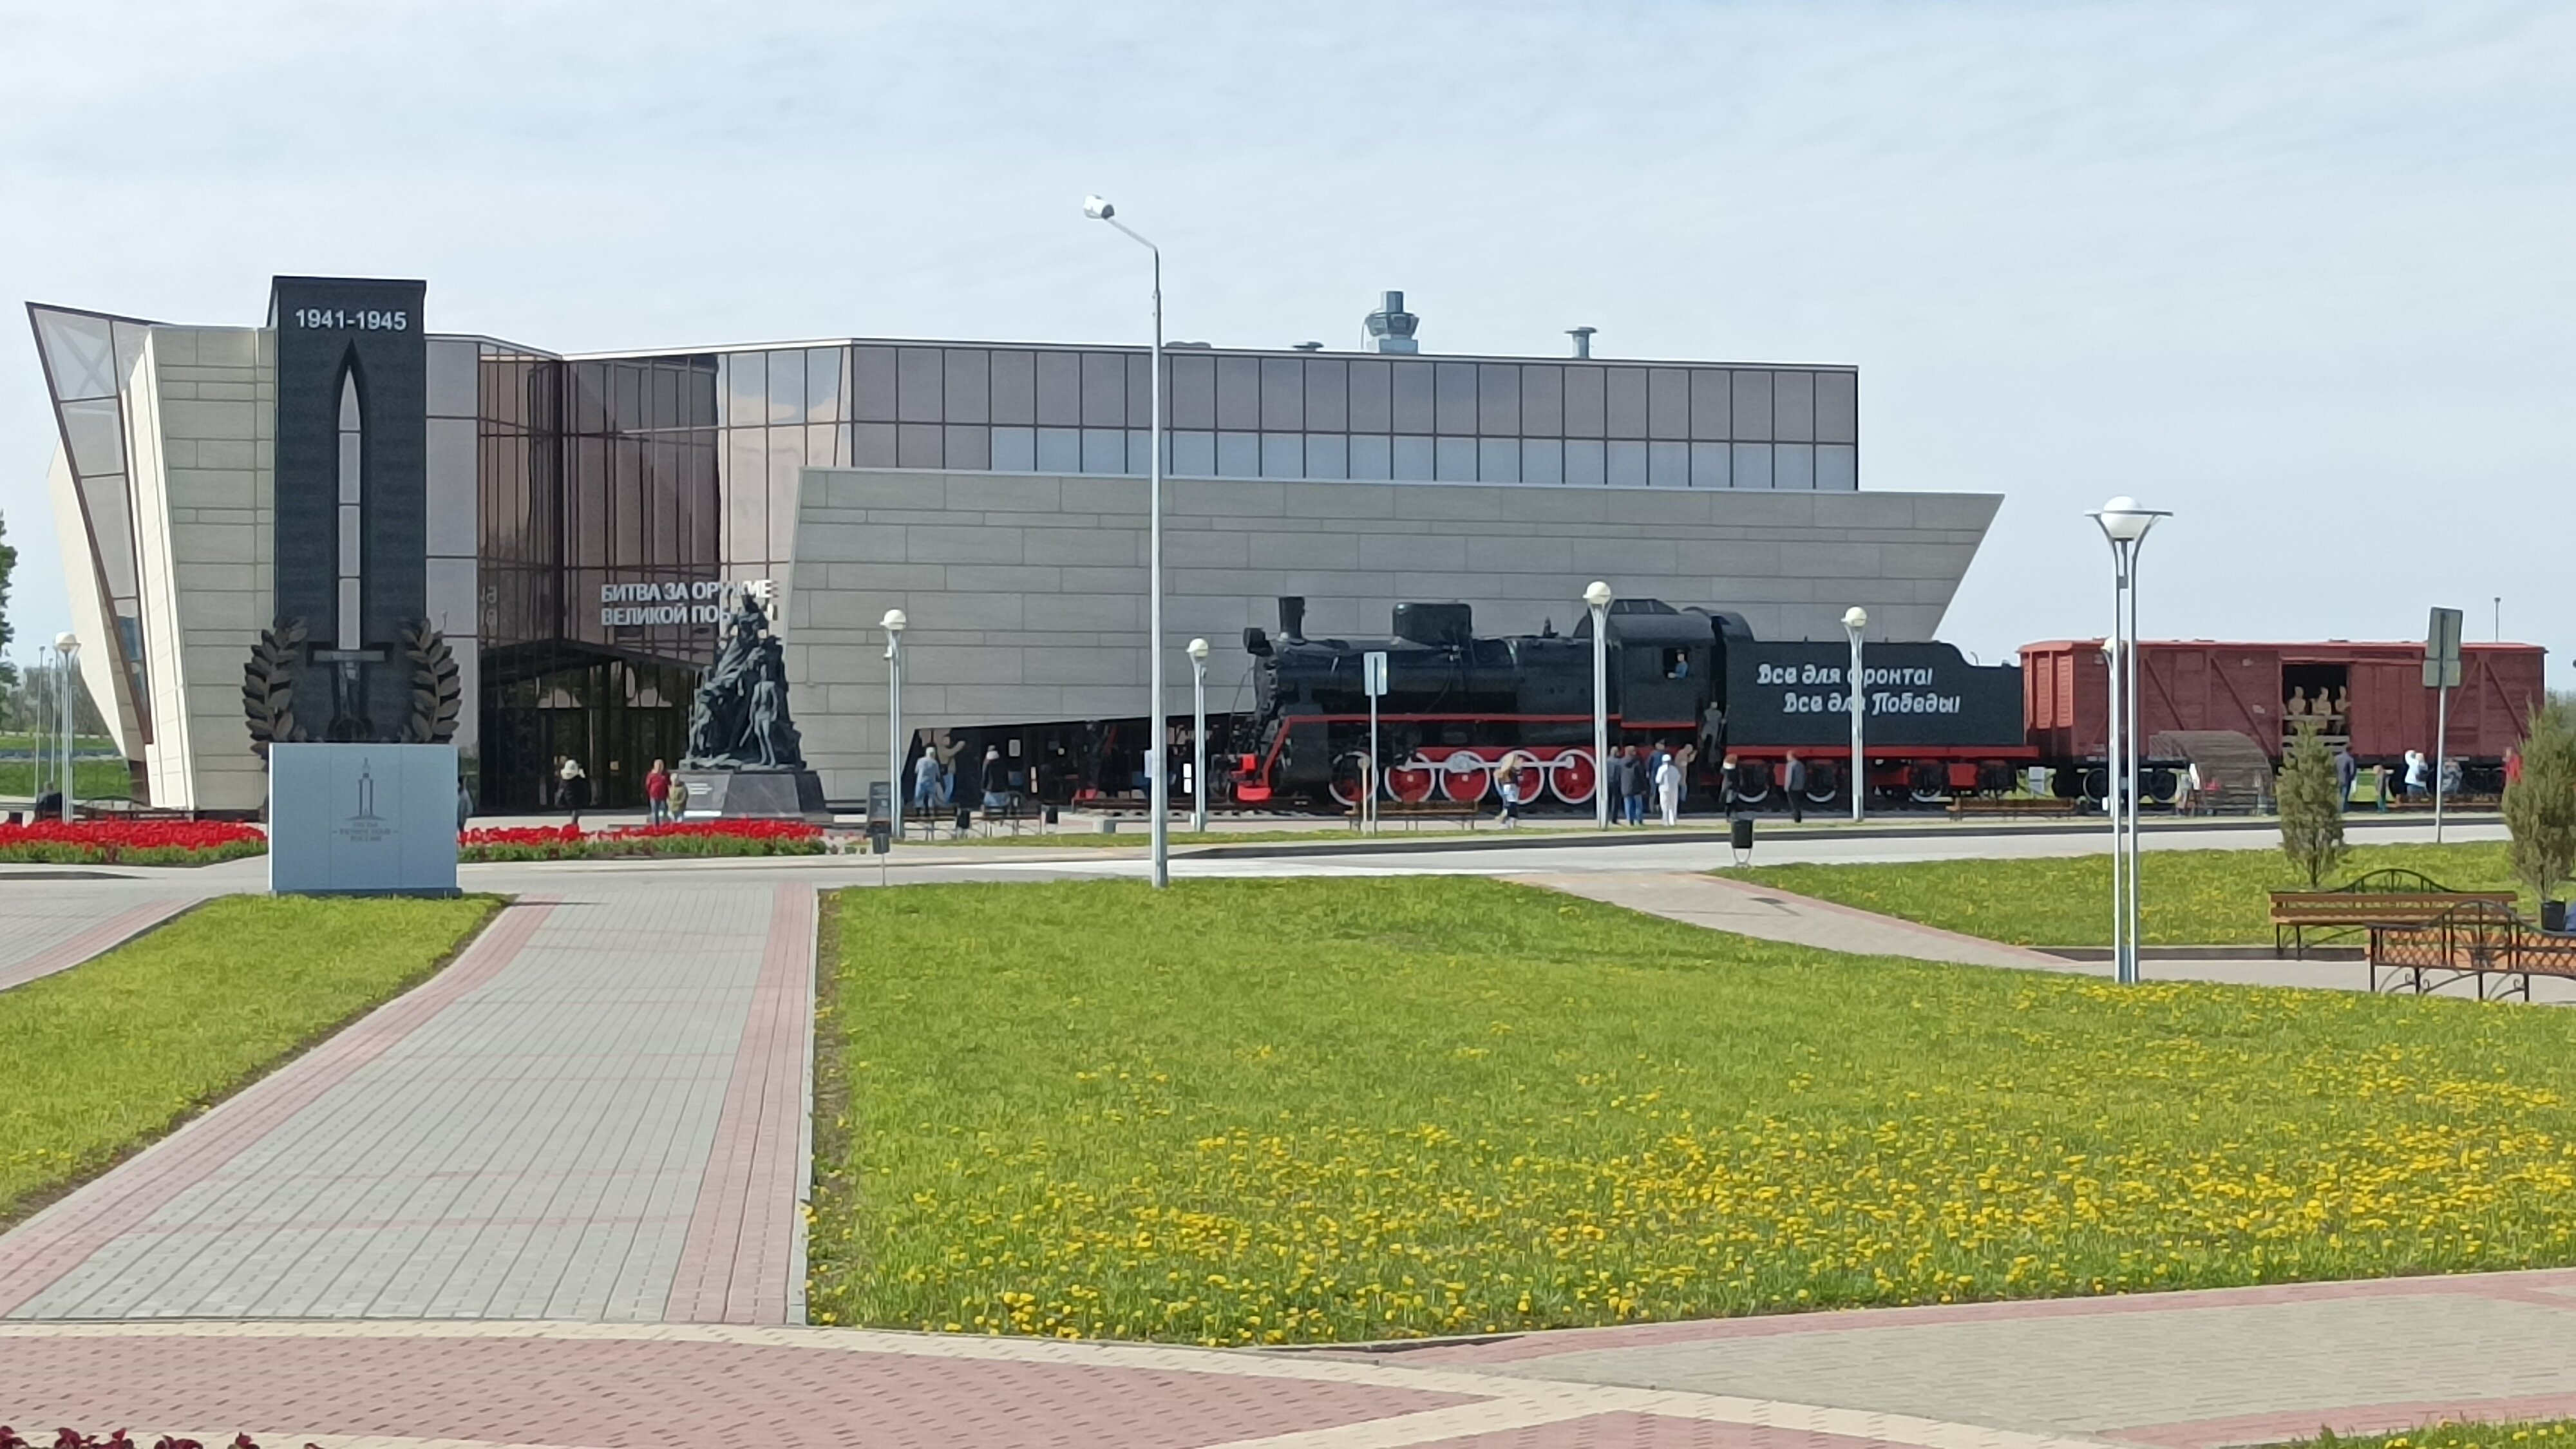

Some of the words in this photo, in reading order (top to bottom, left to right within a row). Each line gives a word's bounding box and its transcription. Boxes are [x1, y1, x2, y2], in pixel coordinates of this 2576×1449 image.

[295, 308, 407, 330] 1941-1945
[601, 582, 661, 602] БИТВА
[664, 582, 689, 601] ЗА
[601, 603, 687, 625] ВЕЛИКОЙ
[1802, 664, 1841, 685] для
[1828, 692, 1866, 713] дл
[1871, 692, 1961, 715] Победы!
